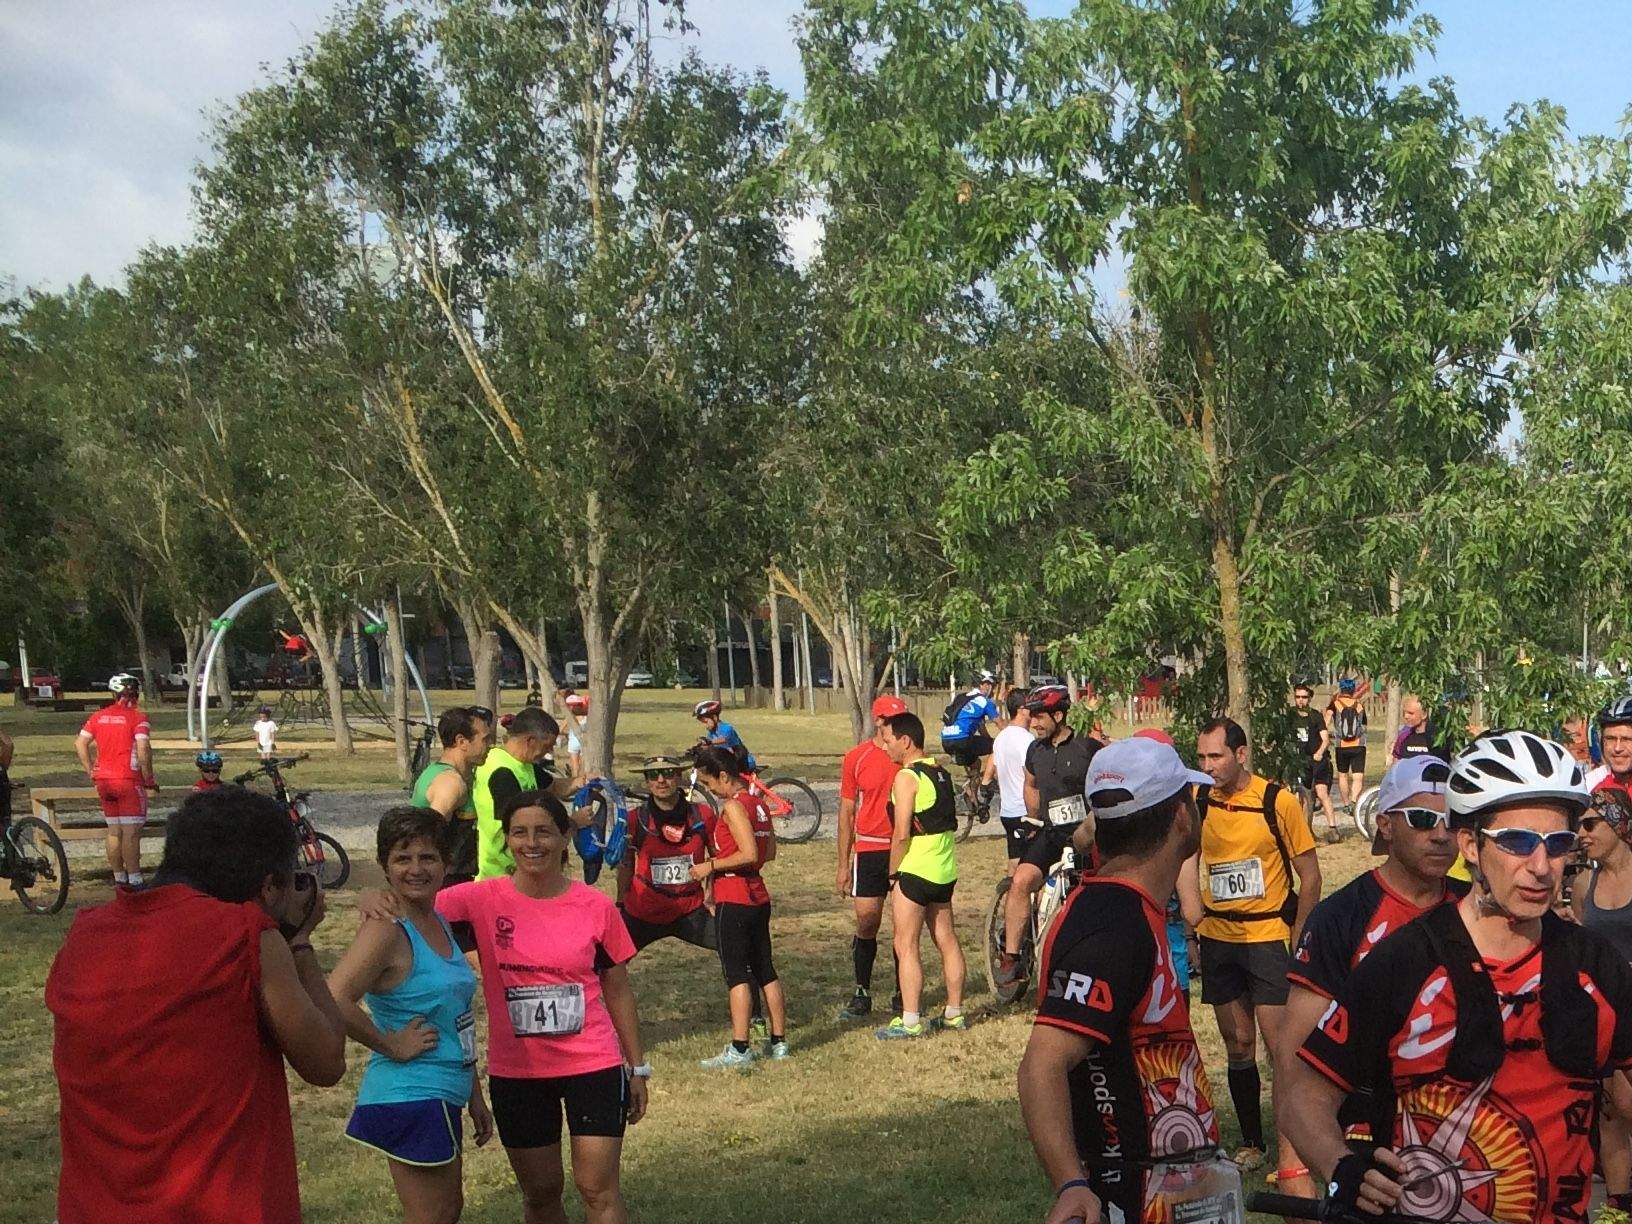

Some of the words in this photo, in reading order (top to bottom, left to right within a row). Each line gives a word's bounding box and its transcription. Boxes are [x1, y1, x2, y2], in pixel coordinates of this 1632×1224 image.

[1060, 806, 1074, 821] 51
[665, 865, 682, 881] 32
[1227, 873, 1247, 894] 60
[534, 1000, 559, 1027] 41
